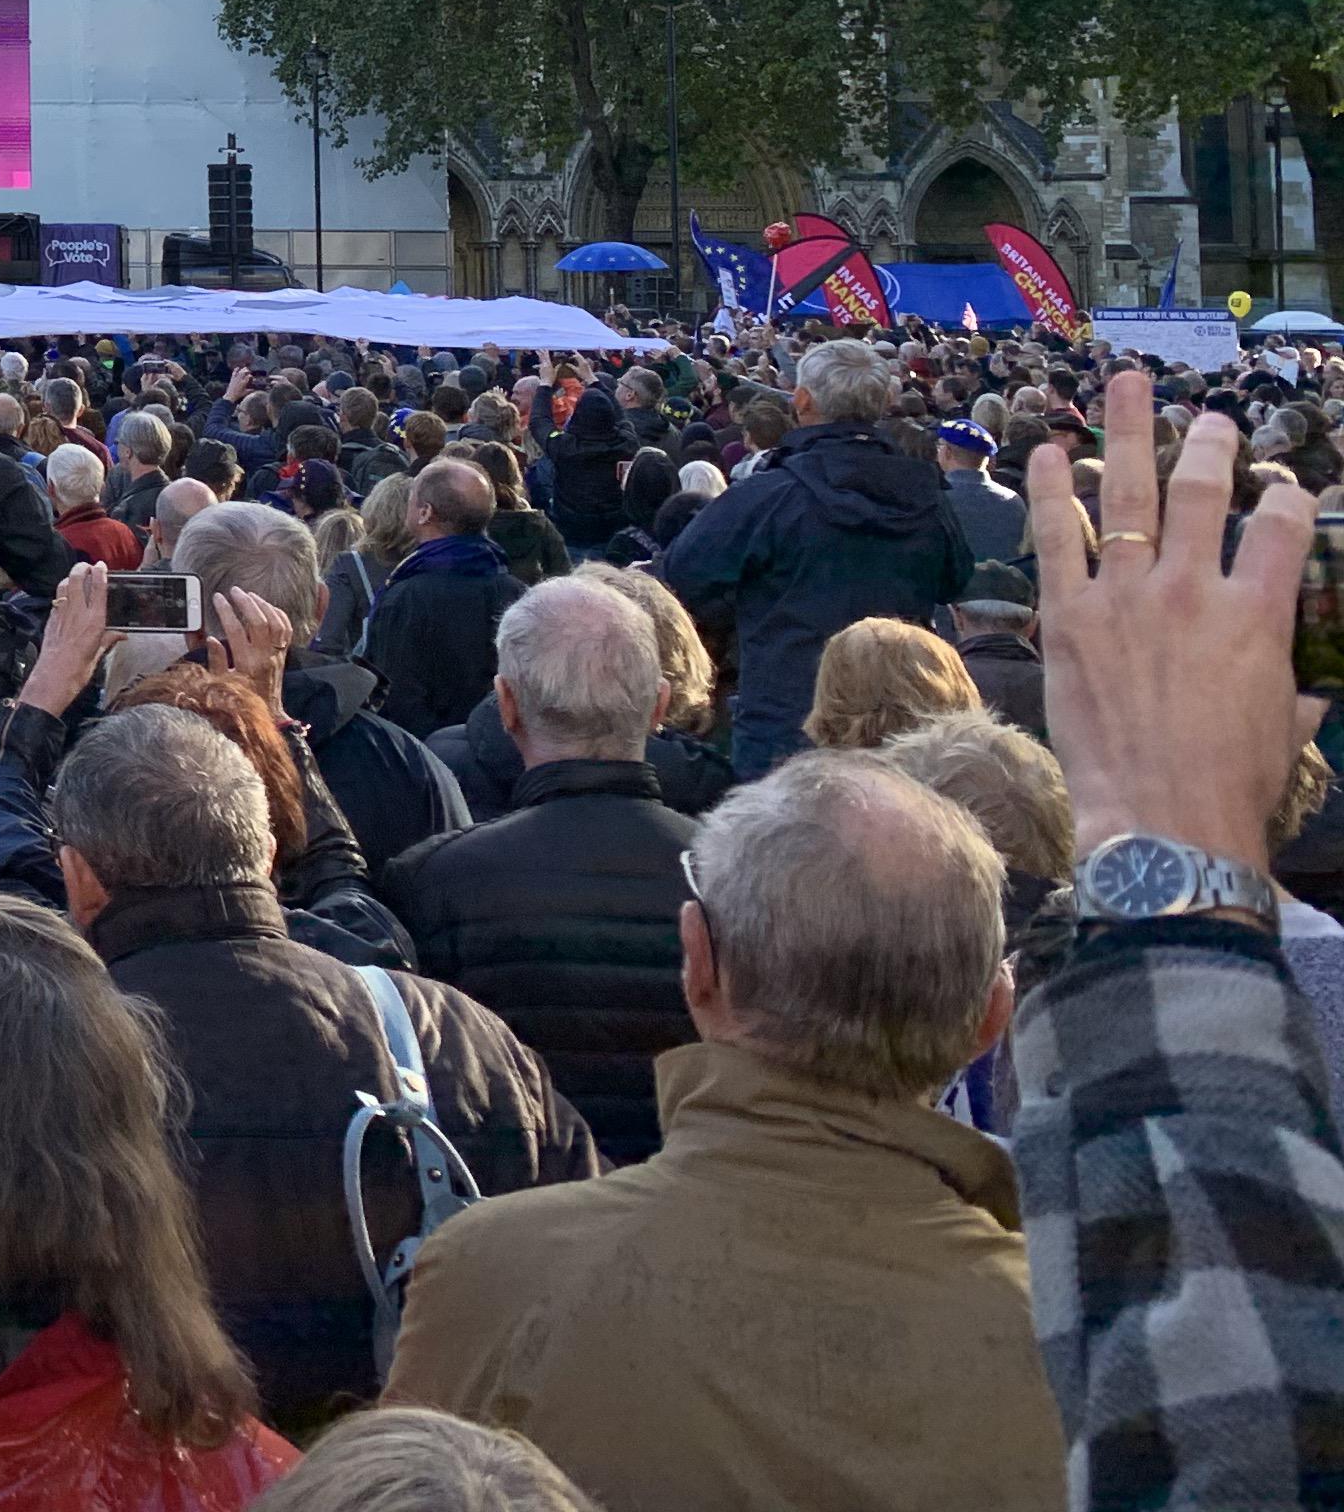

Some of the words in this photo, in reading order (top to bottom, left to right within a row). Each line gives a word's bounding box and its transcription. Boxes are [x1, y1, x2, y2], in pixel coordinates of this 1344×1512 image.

[51, 239, 104, 254] People's
[63, 252, 94, 263] Vote
[1001, 243, 1047, 288] BRITAIN
[1045, 288, 1071, 314] HAS
[851, 282, 879, 310] HAS
[833, 305, 853, 324] ITS
